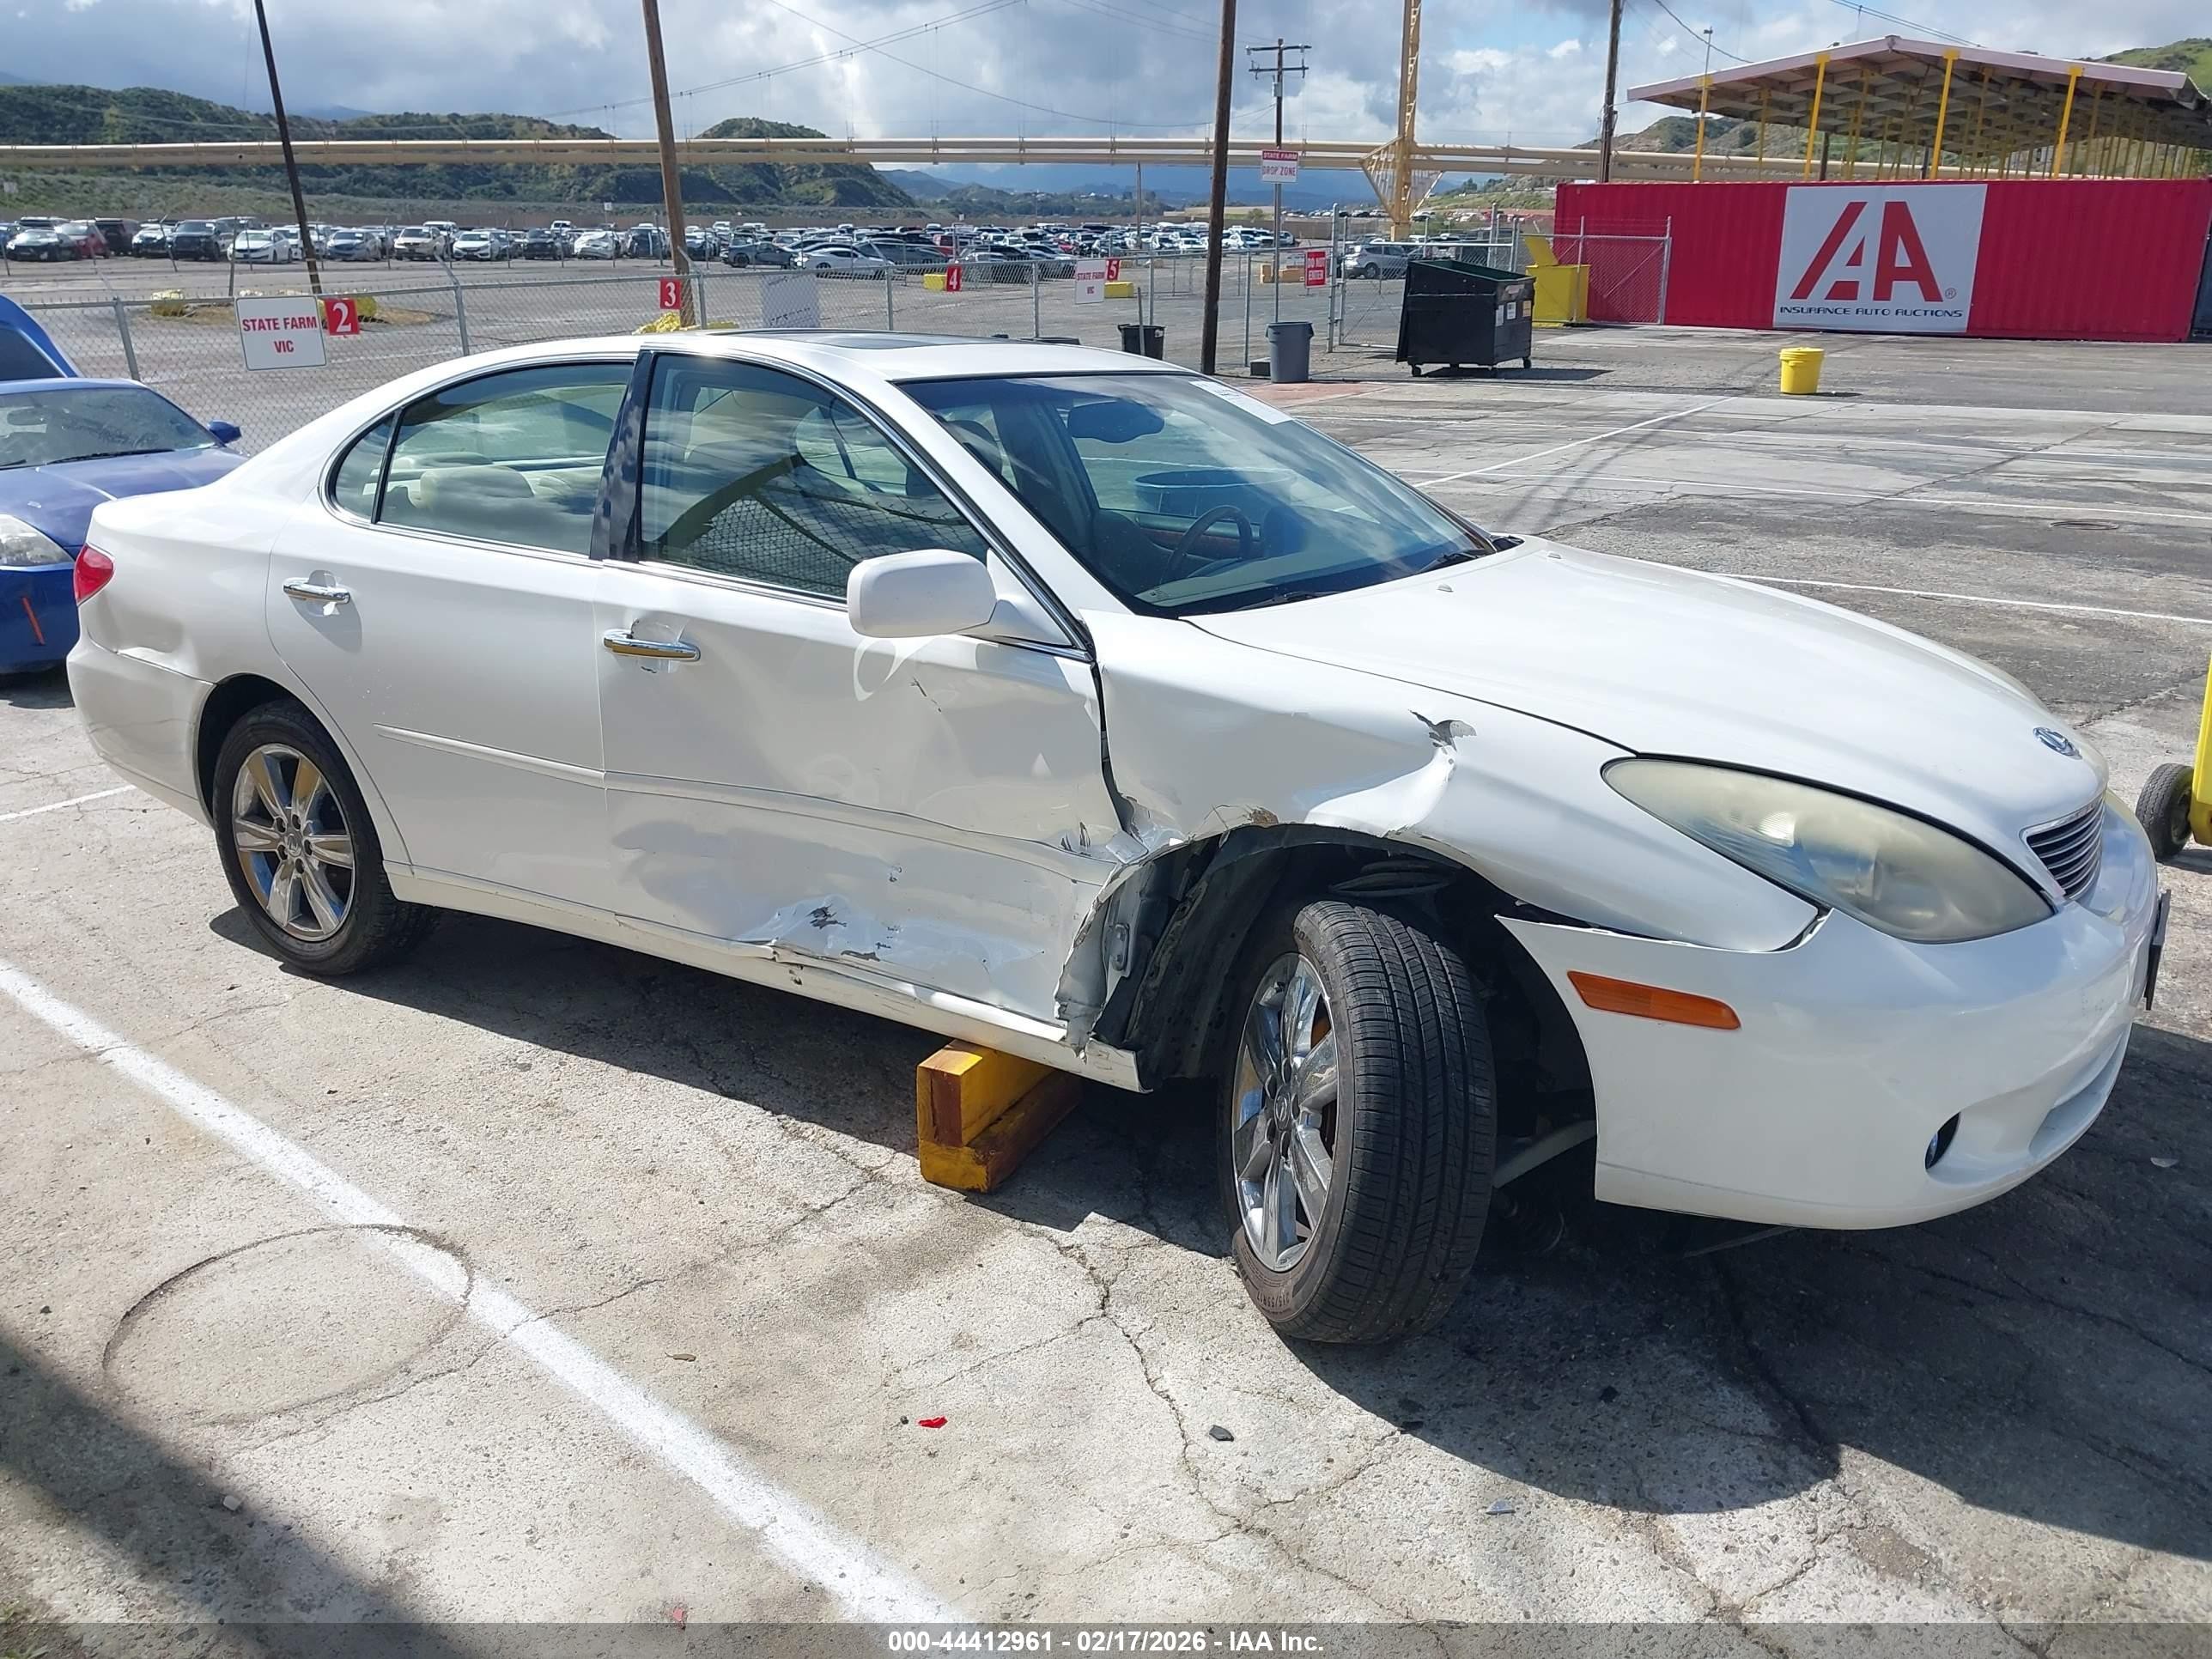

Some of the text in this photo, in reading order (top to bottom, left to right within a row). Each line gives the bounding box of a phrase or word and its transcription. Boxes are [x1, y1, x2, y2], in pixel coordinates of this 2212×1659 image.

[1280, 167, 1296, 176] ZONE
[1109, 260, 1118, 279] 5
[949, 268, 958, 290] 4
[664, 282, 677, 307] 3
[332, 302, 352, 333] 2
[1780, 306, 1963, 318] INSURANCE AUTO AUCTIONS
[242, 316, 318, 332] STATE FARM
[274, 340, 295, 354] VIC
